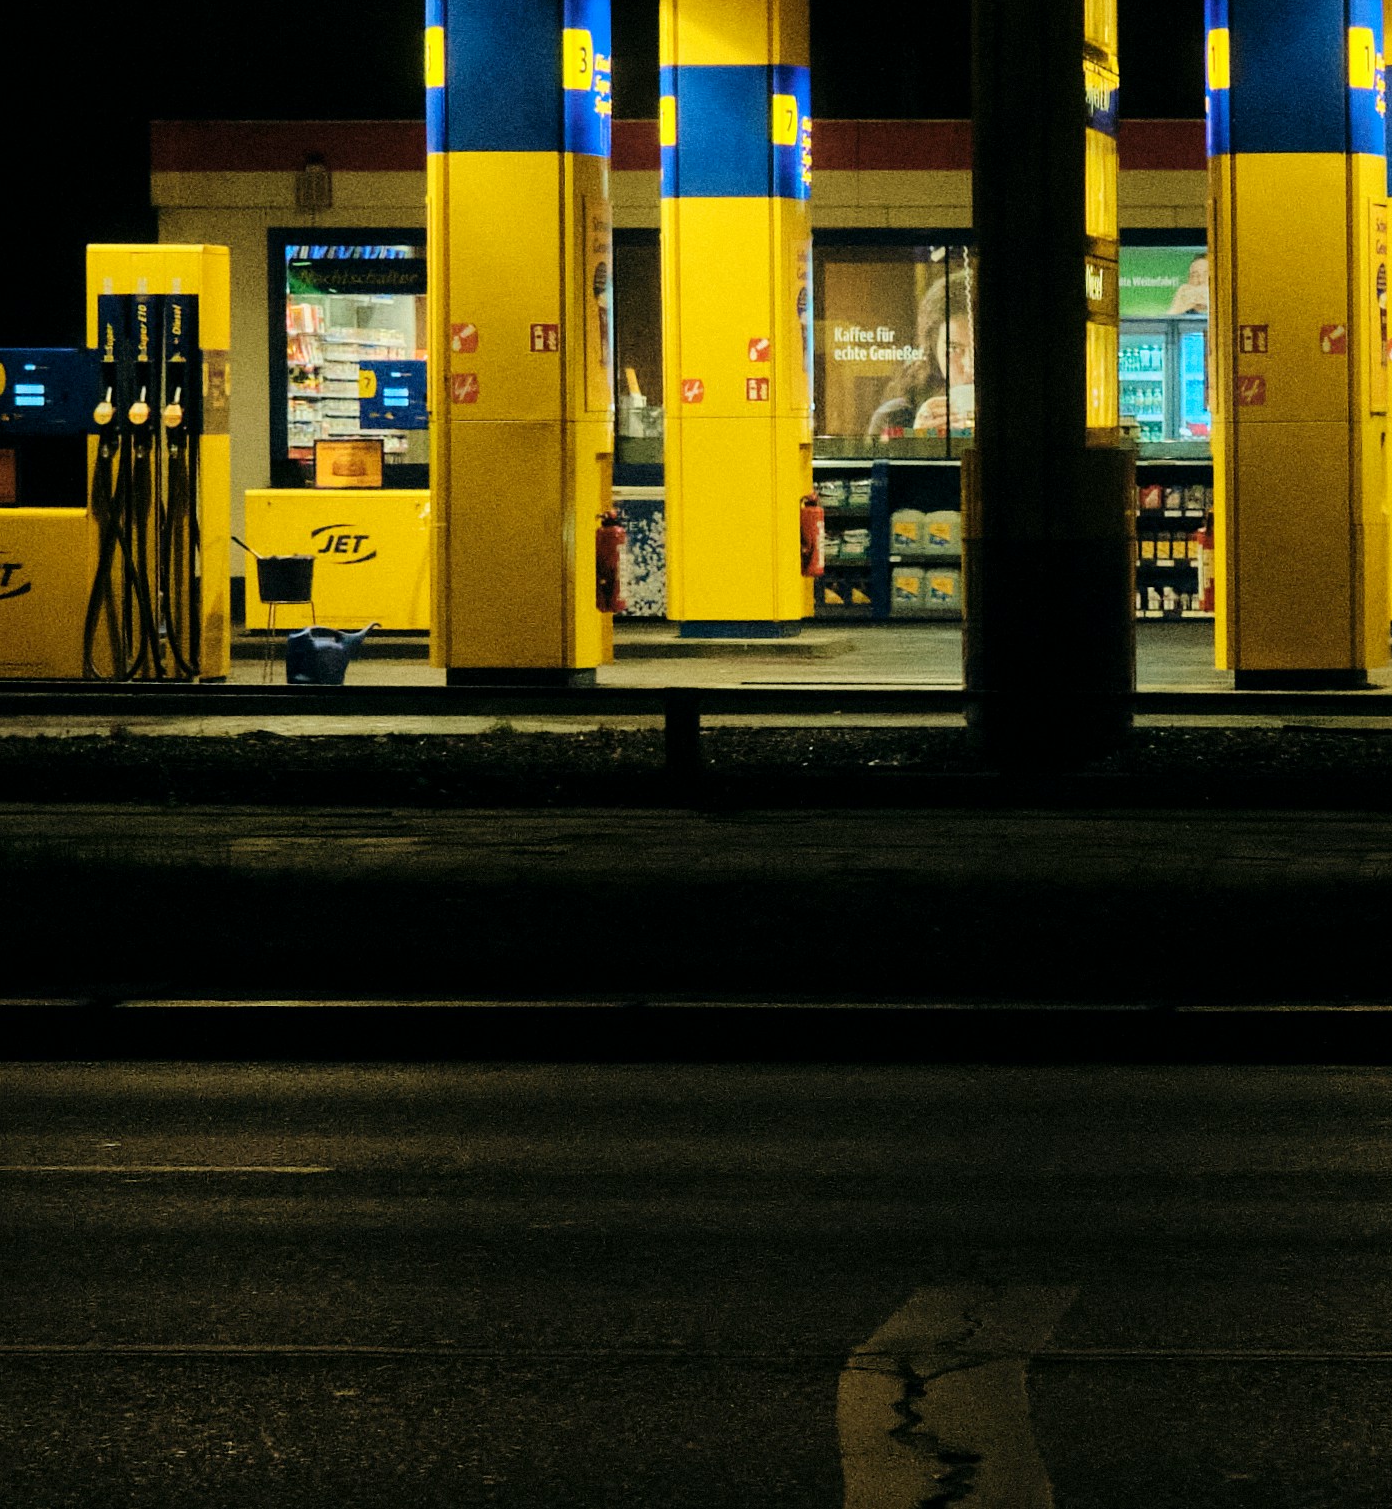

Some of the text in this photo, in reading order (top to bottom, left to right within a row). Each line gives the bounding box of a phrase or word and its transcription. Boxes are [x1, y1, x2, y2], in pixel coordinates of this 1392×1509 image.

[579, 46, 587, 73] 3
[1364, 45, 1370, 72] 1
[785, 109, 793, 132] 7
[137, 303, 150, 350] Super E10
[171, 303, 182, 336] Diesel
[833, 326, 896, 343] Kaffee für
[833, 345, 927, 363] echte Genießer.
[317, 534, 370, 553] JET
